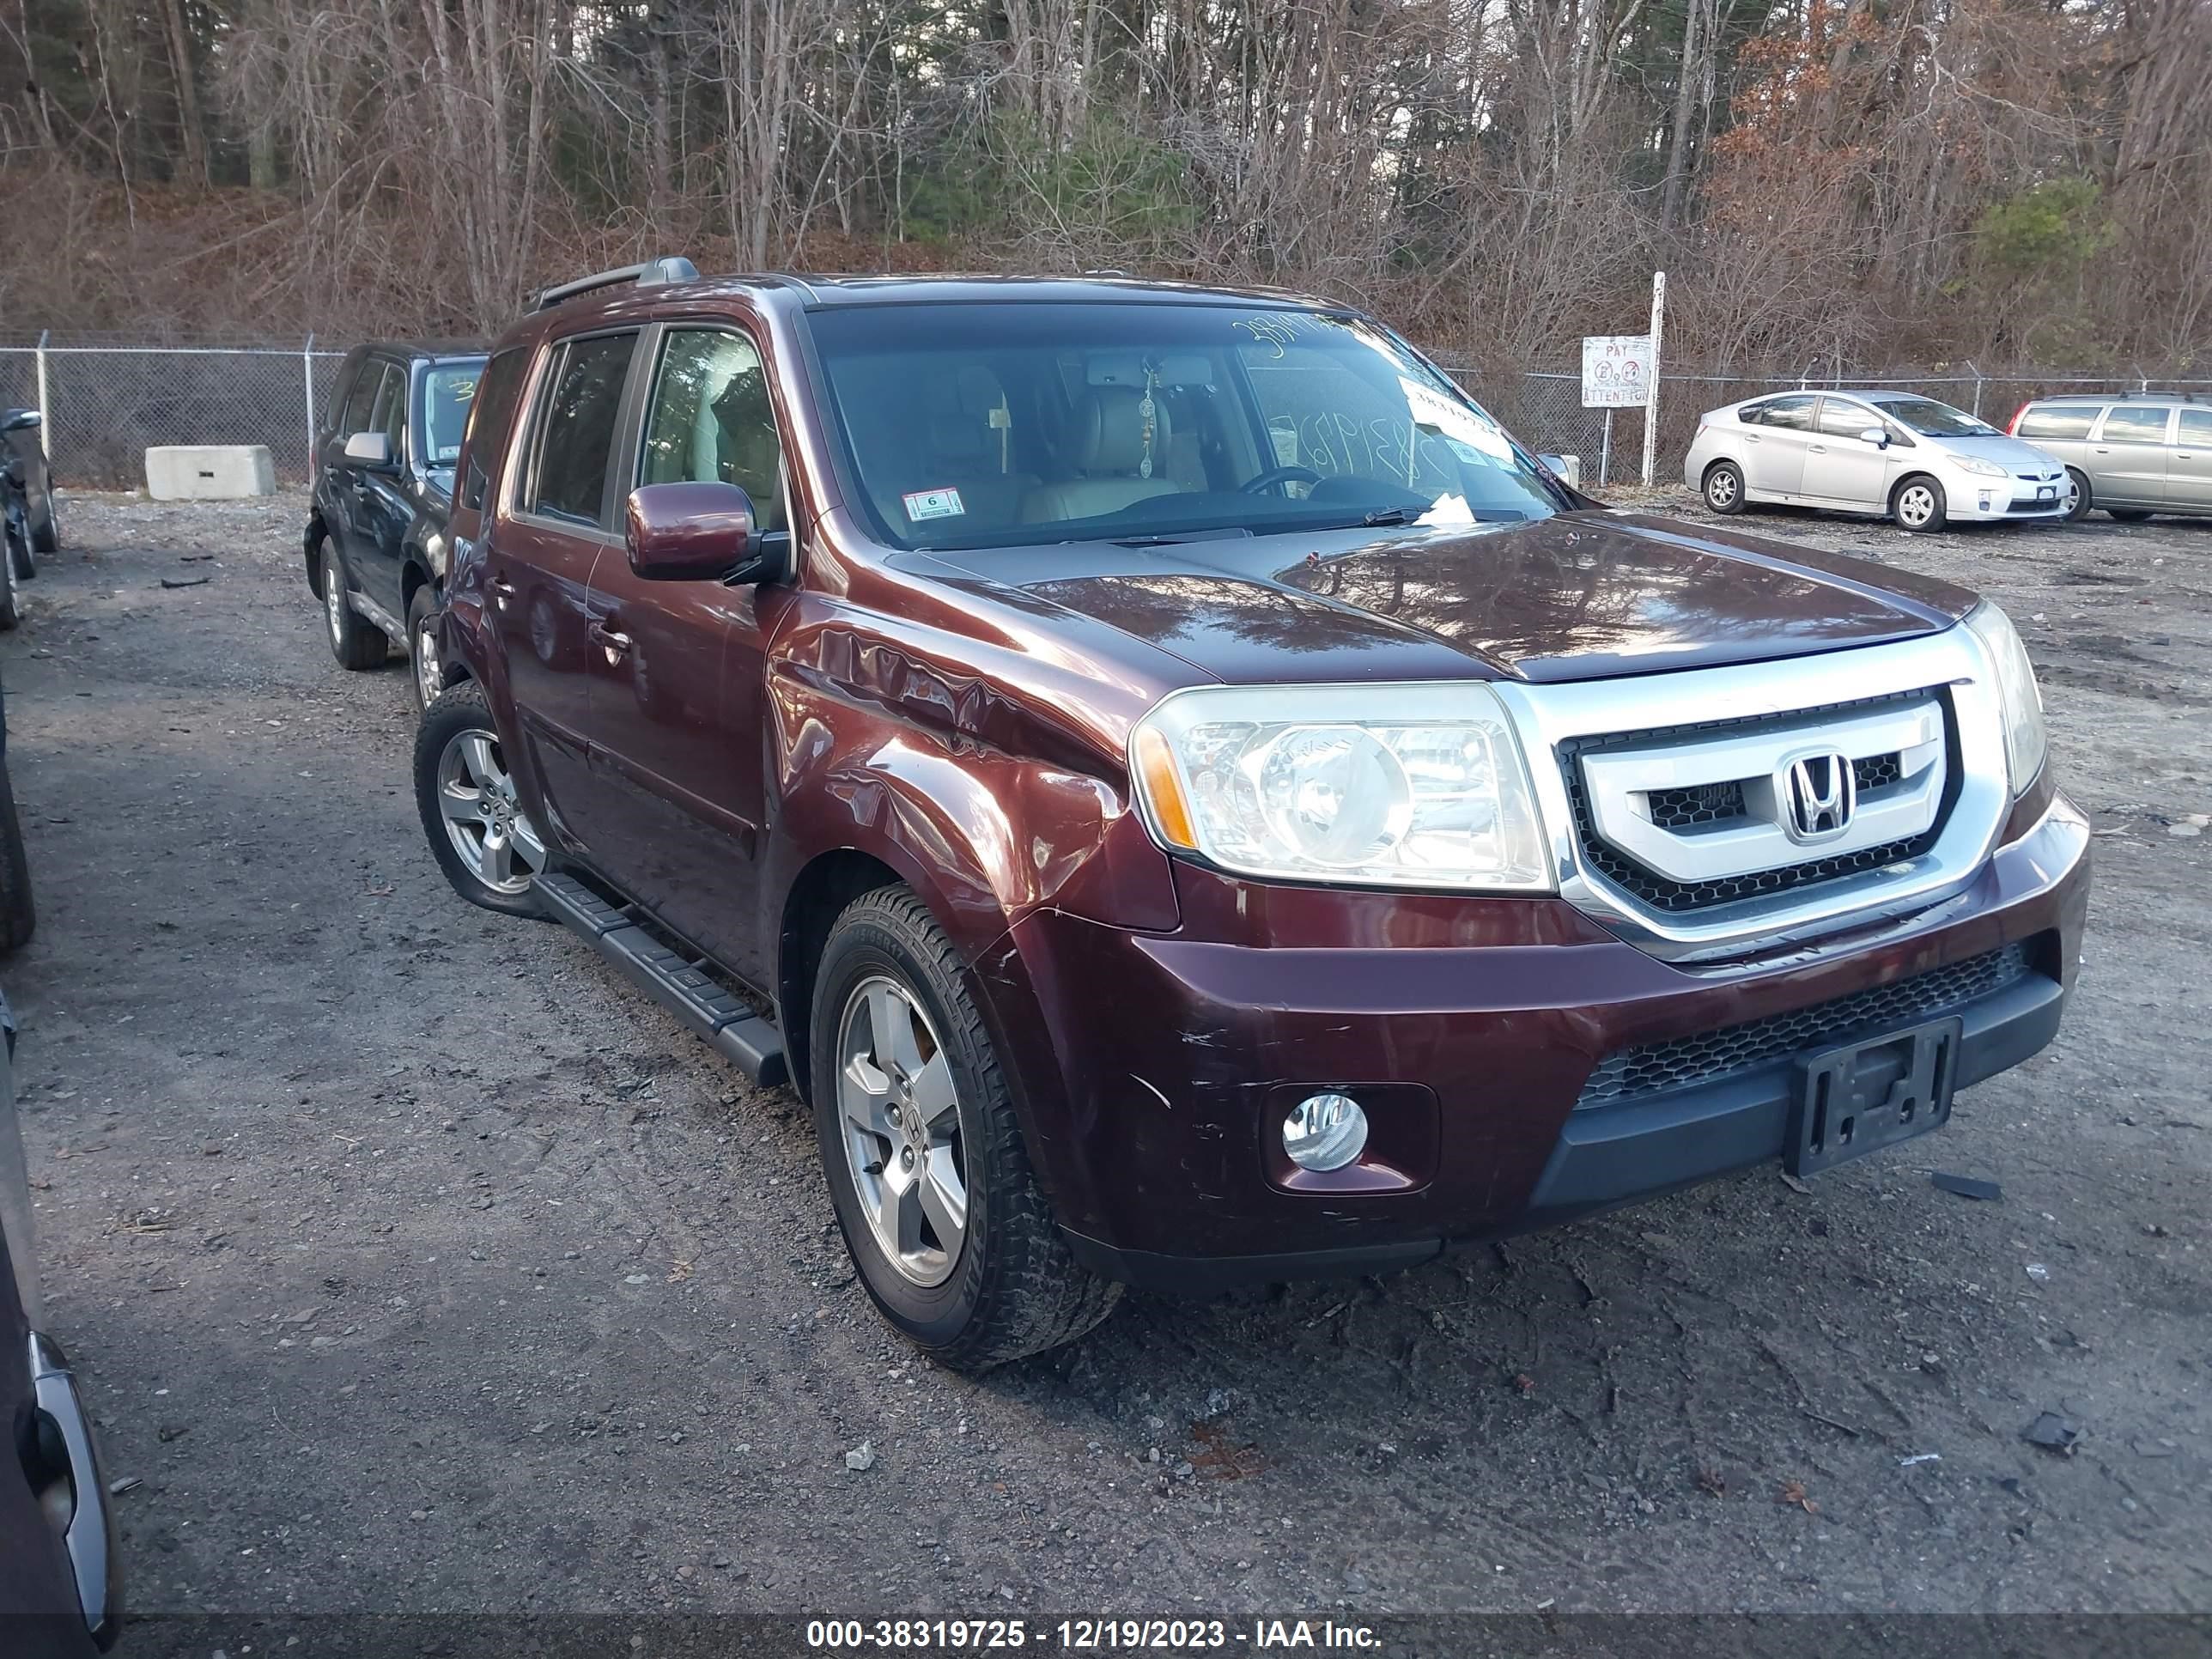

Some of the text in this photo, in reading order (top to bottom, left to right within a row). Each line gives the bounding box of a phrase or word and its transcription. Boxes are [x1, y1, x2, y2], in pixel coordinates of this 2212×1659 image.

[1606, 345, 1628, 357] PAY
[1583, 389, 1649, 404] ATTENTION
[927, 496, 937, 506] 6
